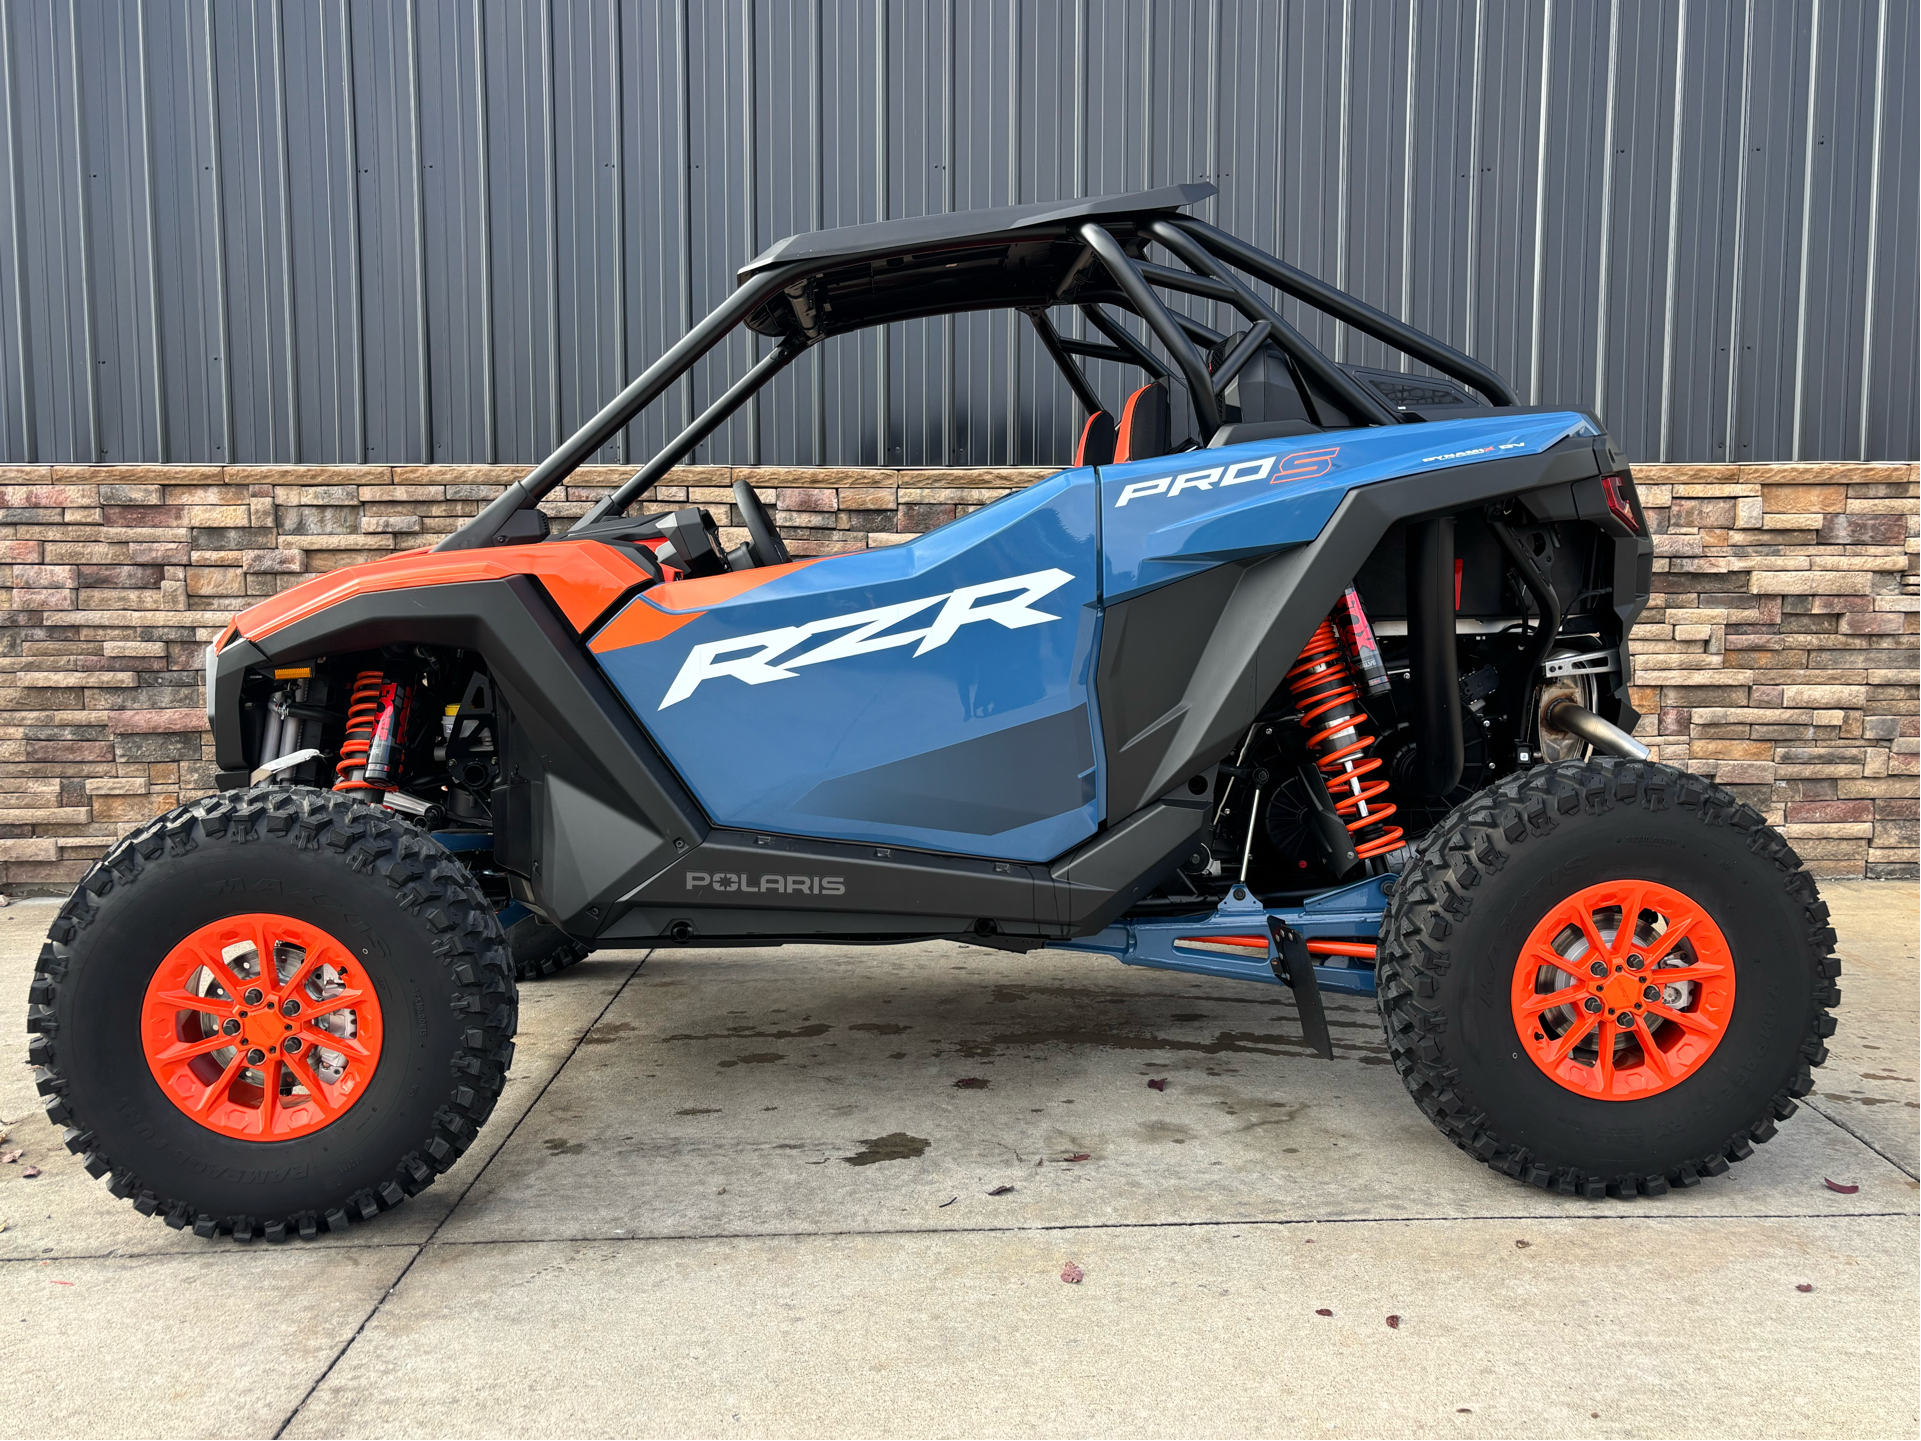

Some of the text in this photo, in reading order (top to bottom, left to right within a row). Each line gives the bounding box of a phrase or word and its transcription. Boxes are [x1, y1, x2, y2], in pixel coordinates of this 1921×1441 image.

[657, 567, 1076, 711] RZR
[1336, 591, 1376, 656] FOX
[370, 682, 398, 741] FOX
[686, 871, 846, 895] POLARIS
